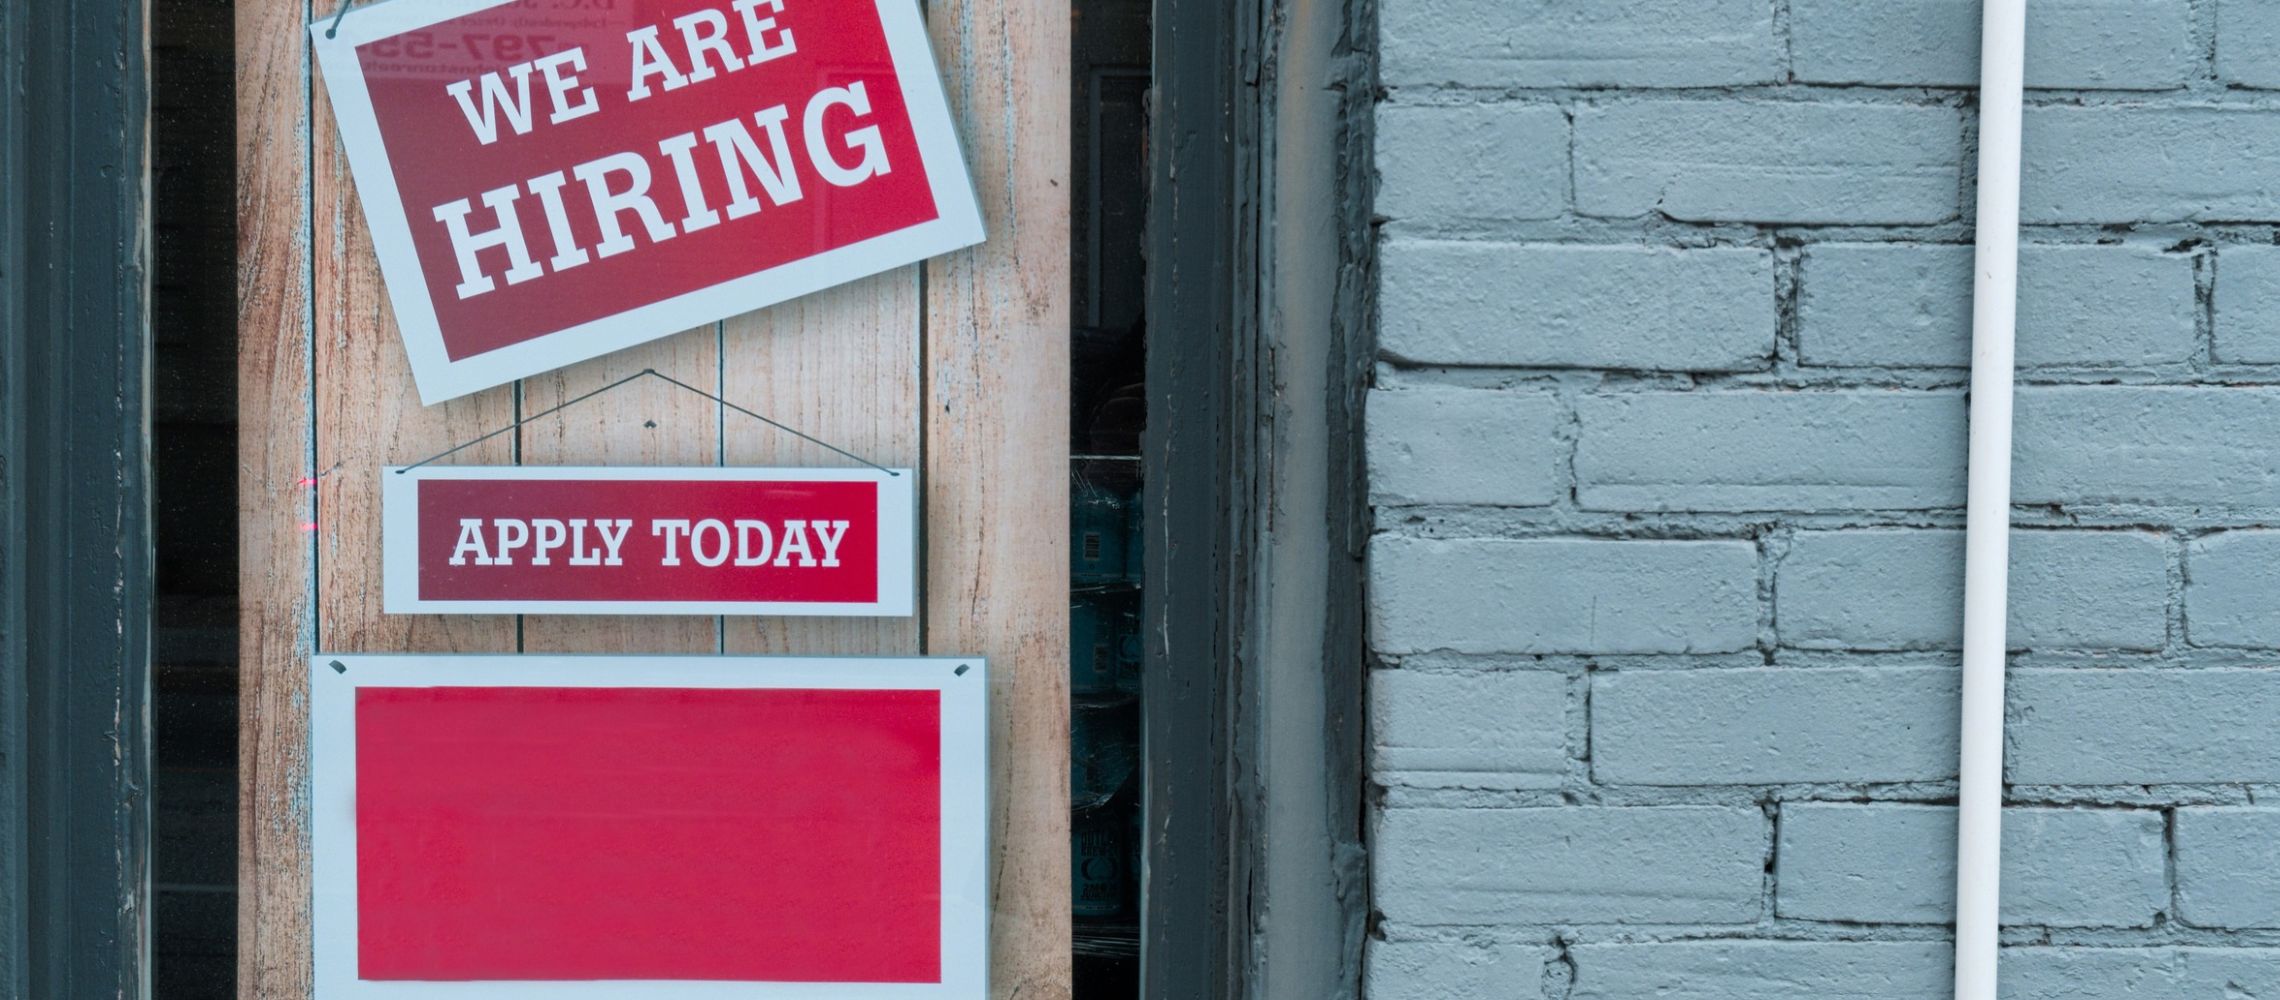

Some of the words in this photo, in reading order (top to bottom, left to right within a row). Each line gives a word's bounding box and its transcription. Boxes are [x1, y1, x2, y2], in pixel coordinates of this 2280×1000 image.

[446, 47, 600, 146] WE
[626, 0, 798, 103] ARE
[432, 81, 892, 301] HIRING
[449, 518, 632, 567] APPLY
[652, 519, 850, 568] TODAY
